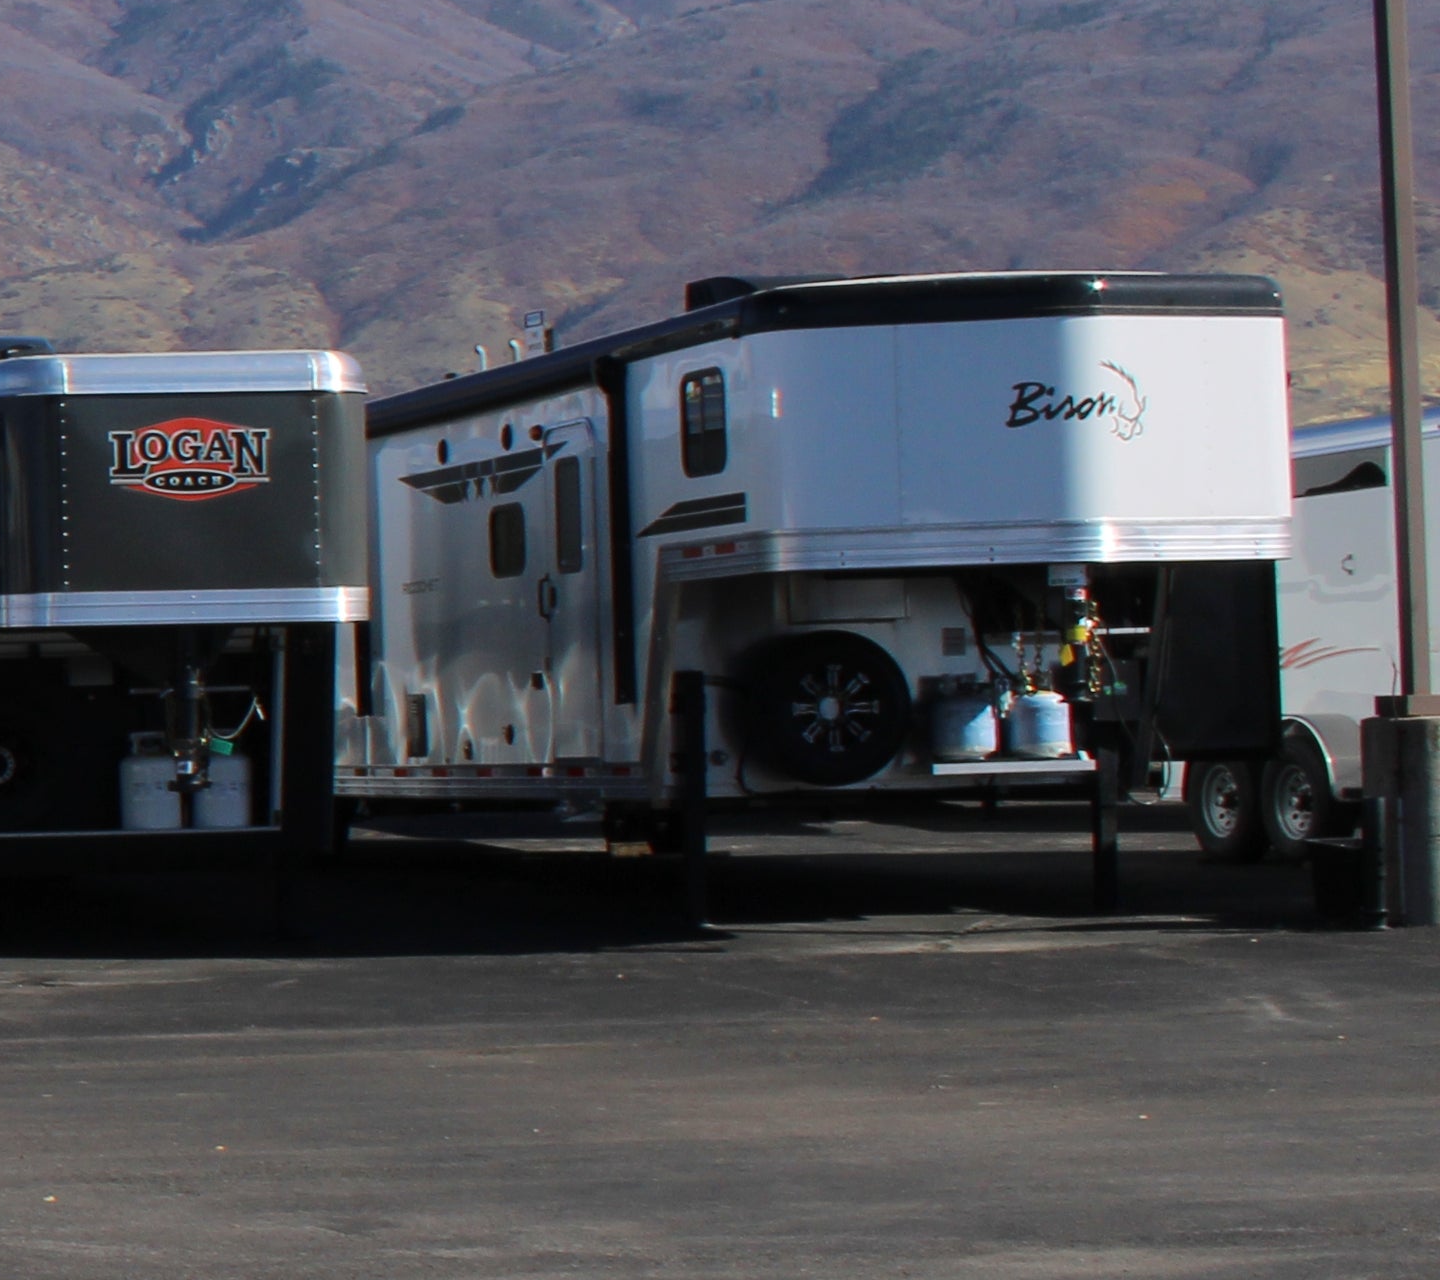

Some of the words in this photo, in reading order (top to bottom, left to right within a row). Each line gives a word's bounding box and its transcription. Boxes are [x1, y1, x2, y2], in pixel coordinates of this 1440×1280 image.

[1005, 381, 1115, 428] Bison
[108, 428, 271, 477] LOGAN
[154, 475, 223, 487] COACH
